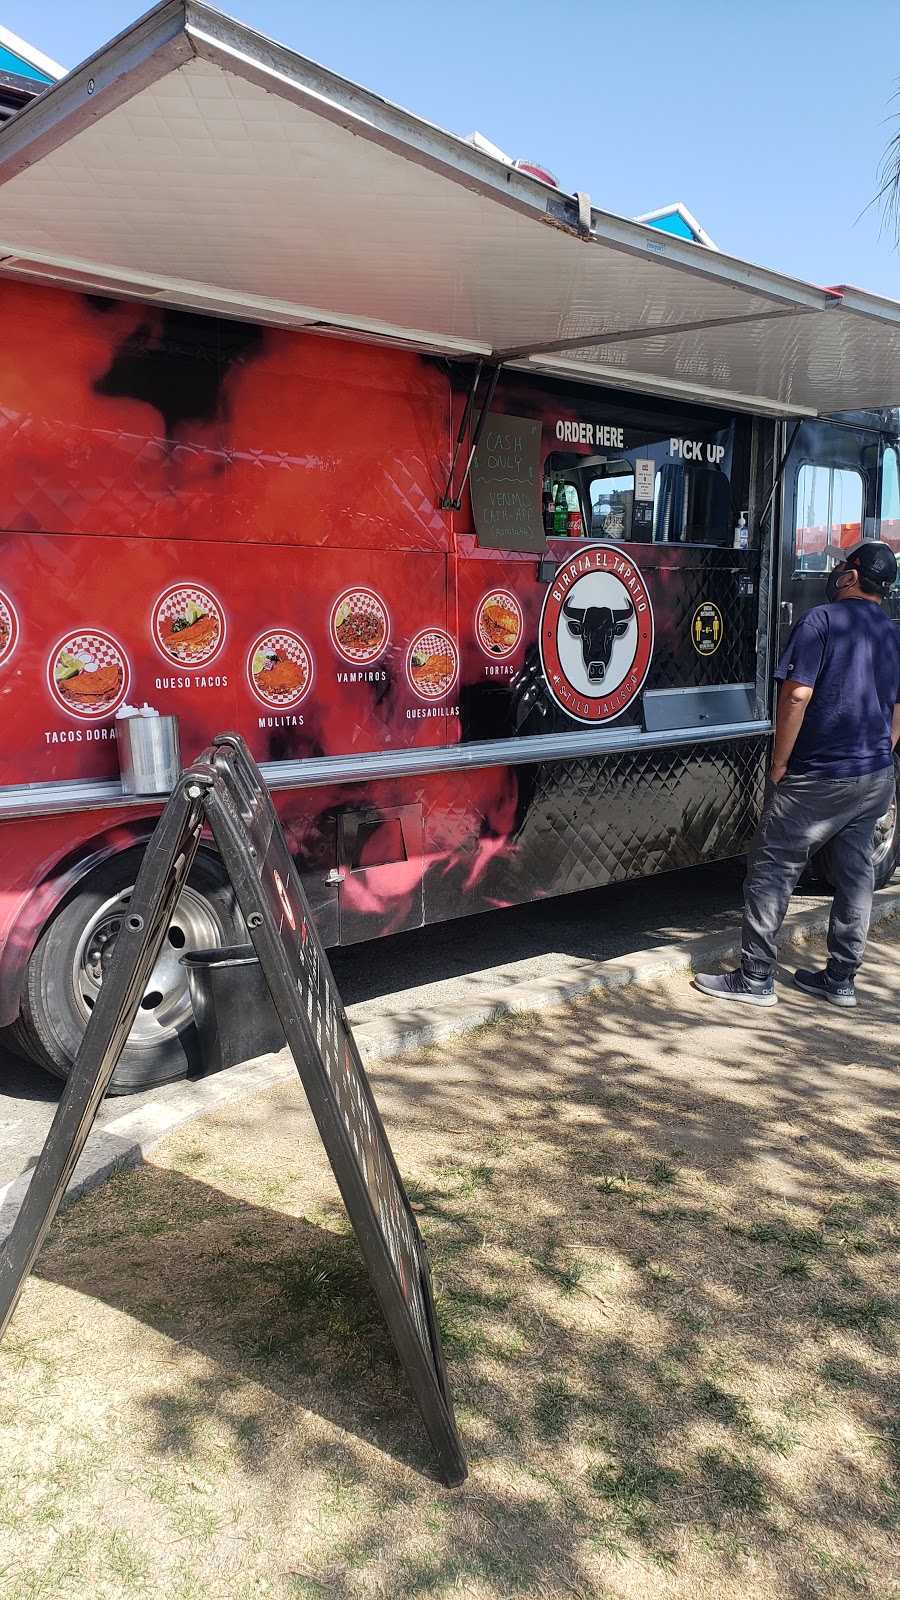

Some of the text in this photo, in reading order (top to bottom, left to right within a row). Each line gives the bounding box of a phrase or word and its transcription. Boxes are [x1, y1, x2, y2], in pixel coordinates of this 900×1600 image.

[487, 432, 522, 453] CASH
[556, 420, 624, 448] ORDER HERE
[669, 437, 725, 464] PICK UP
[488, 455, 522, 473] ONLY
[489, 491, 532, 508] VENMO
[552, 553, 647, 613] BIRRIA EL TAPATIO
[336, 671, 387, 683] VAMPIROS
[484, 665, 514, 676] TORTAS
[155, 676, 229, 690] QUESO TACOS
[554, 675, 638, 716] ESTILO JALISCO
[258, 715, 305, 728] MULITAS
[405, 706, 460, 720] QUESADILLAS
[44, 728, 116, 744] TACOS DORA
